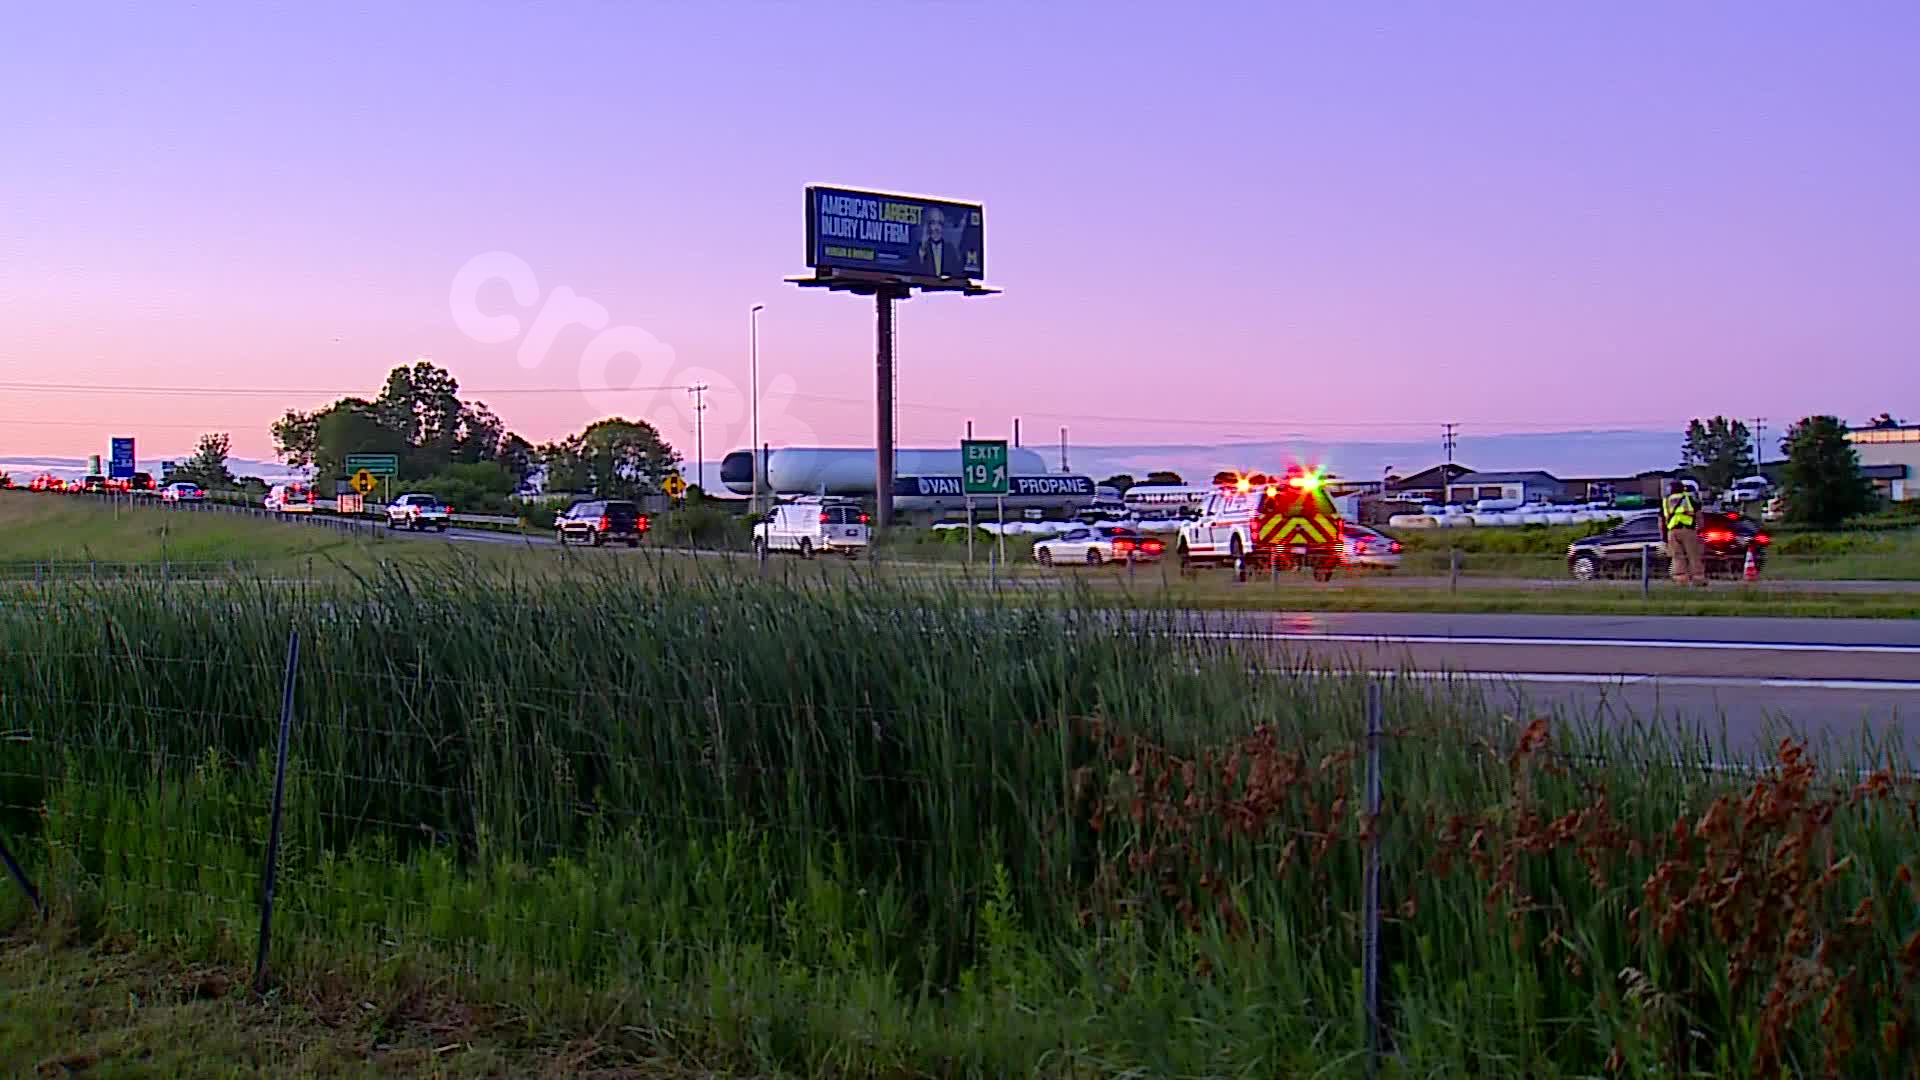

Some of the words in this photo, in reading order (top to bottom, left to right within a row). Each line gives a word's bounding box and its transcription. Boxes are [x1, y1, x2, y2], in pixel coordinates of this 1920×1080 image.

[821, 194, 877, 220] AMERICA'S
[879, 201, 924, 225] LARGEST
[821, 215, 858, 238] INJURY
[860, 220, 883, 242] LAW
[884, 222, 910, 244] FIRM
[969, 446, 1001, 460] EXIT
[965, 465, 987, 484] 19
[1018, 478, 1088, 493] PROPANE
